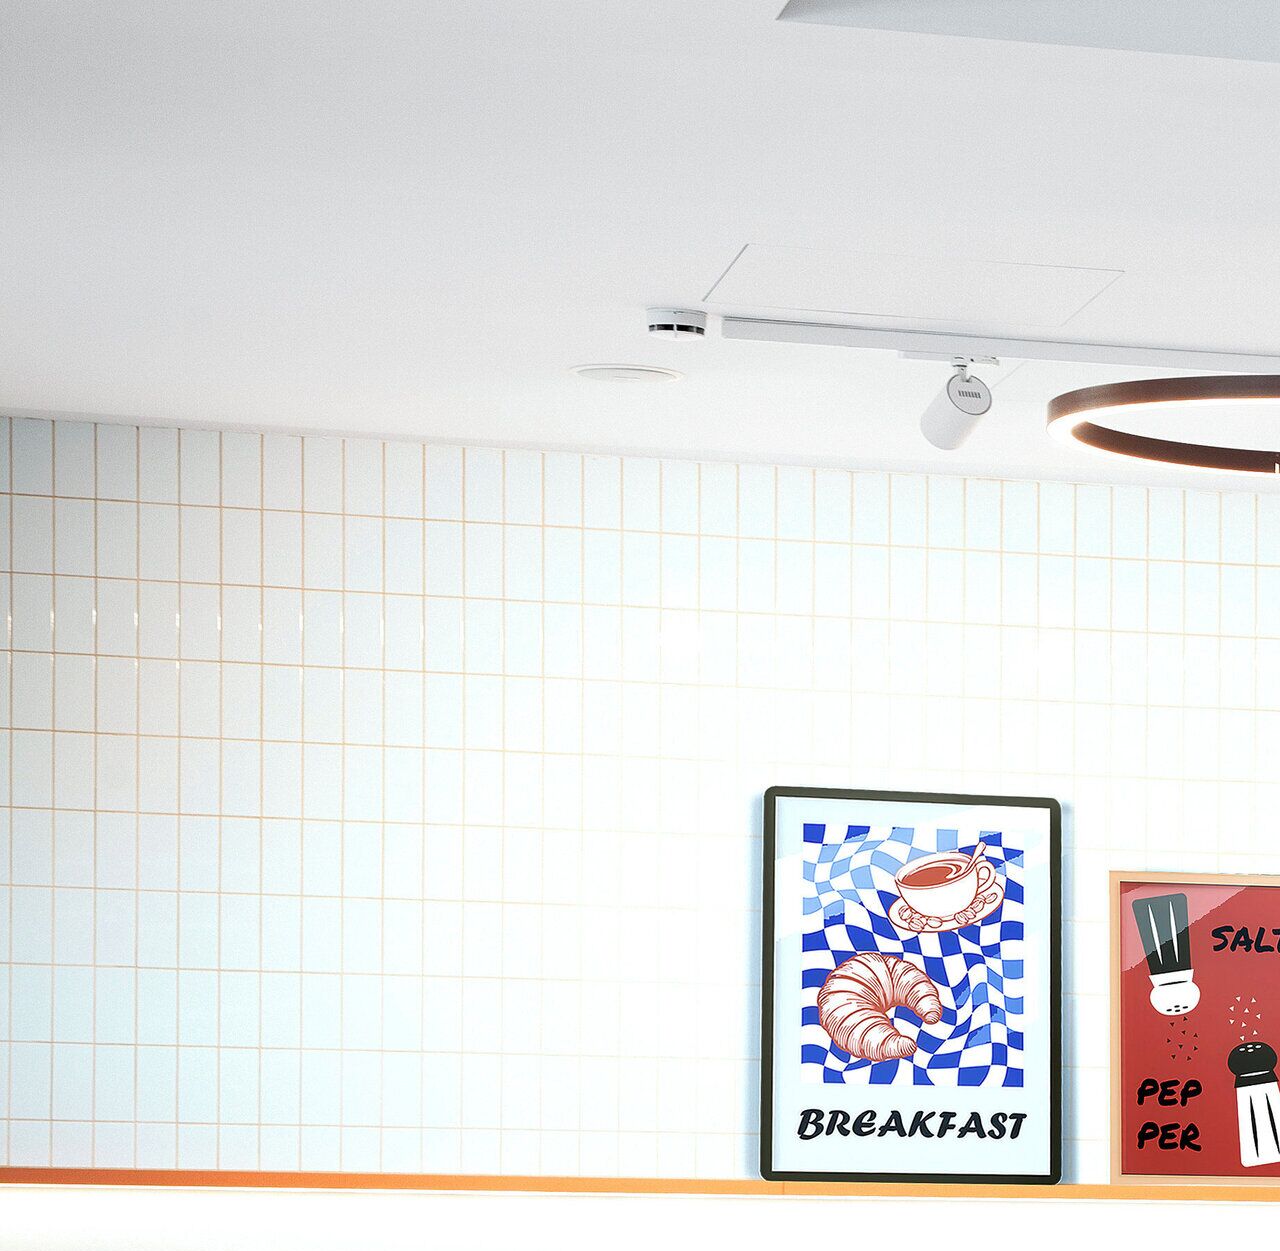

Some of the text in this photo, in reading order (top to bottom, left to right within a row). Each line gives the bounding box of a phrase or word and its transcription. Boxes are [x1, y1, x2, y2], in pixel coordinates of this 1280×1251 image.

[1136, 1078, 1203, 1107] PEP
[796, 1107, 1029, 1142] BREAKFAST
[1137, 1121, 1202, 1152] PER
